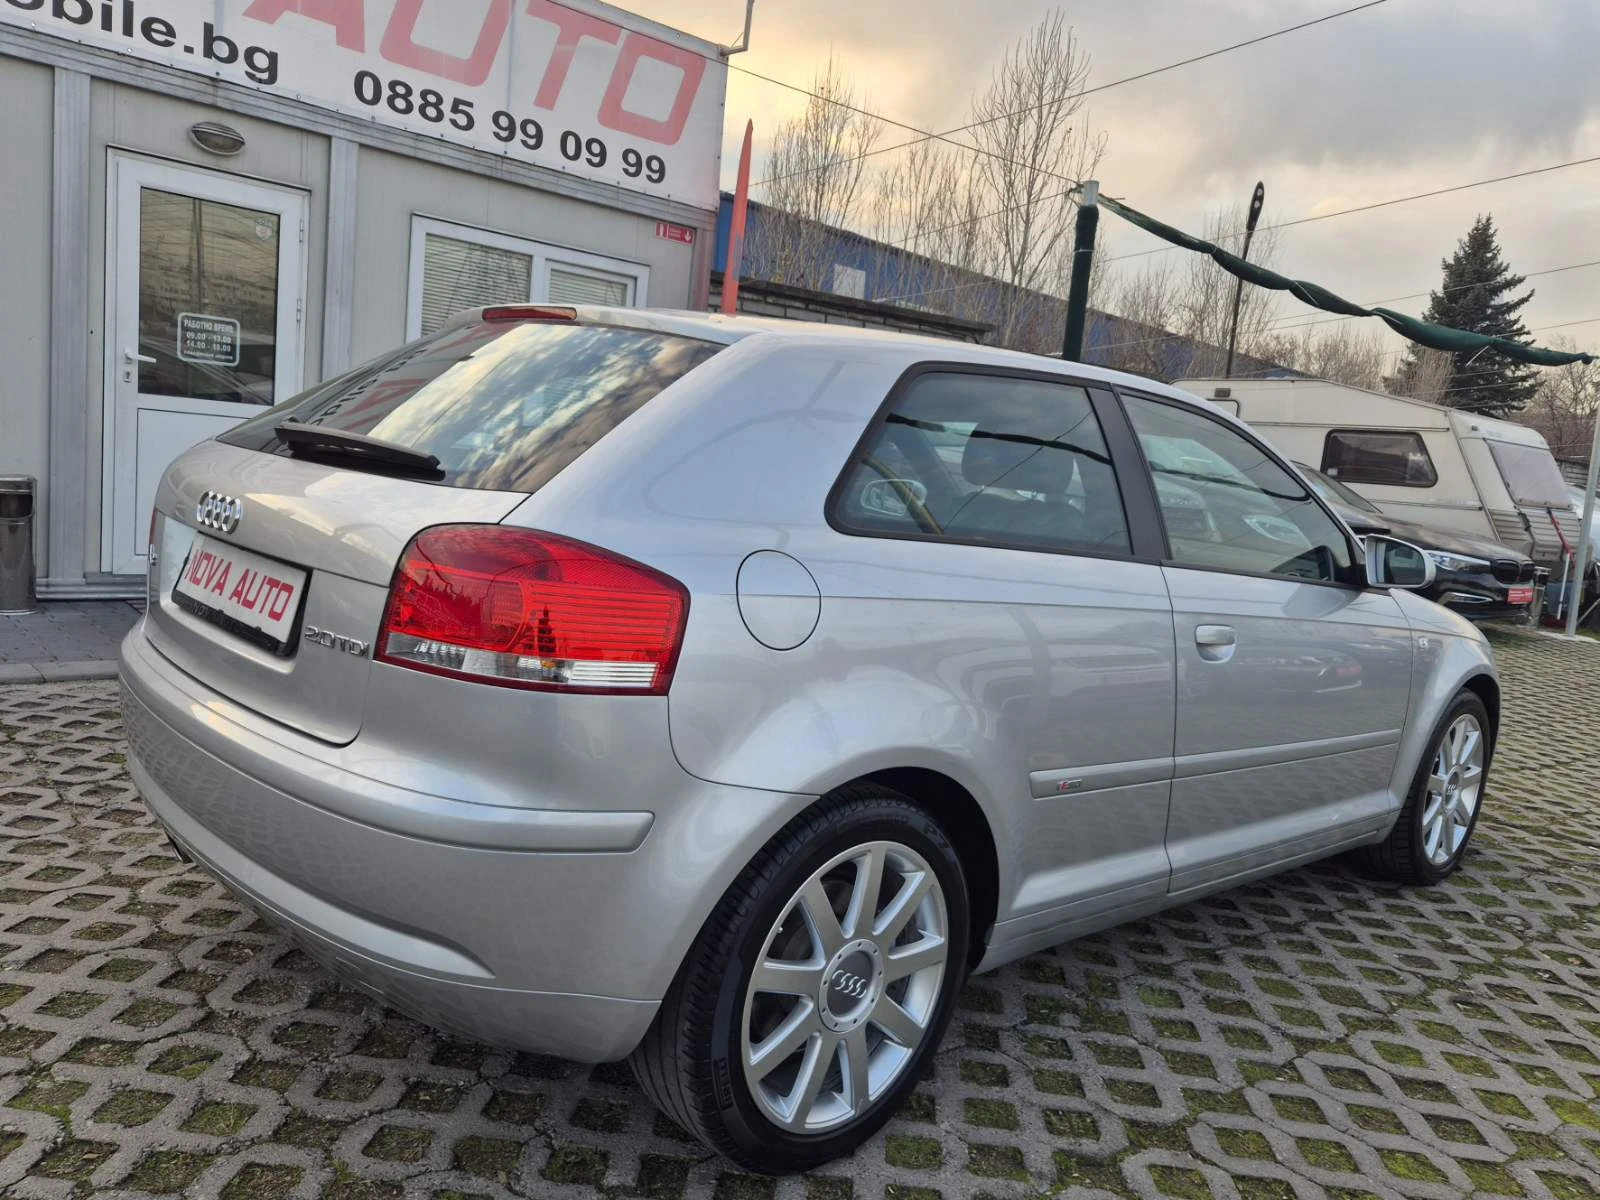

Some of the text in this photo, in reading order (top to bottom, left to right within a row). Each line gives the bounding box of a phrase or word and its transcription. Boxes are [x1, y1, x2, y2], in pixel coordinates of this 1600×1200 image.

[353, 69, 667, 184] 0885 99 09 99
[184, 549, 295, 622] NOVA AUTO
